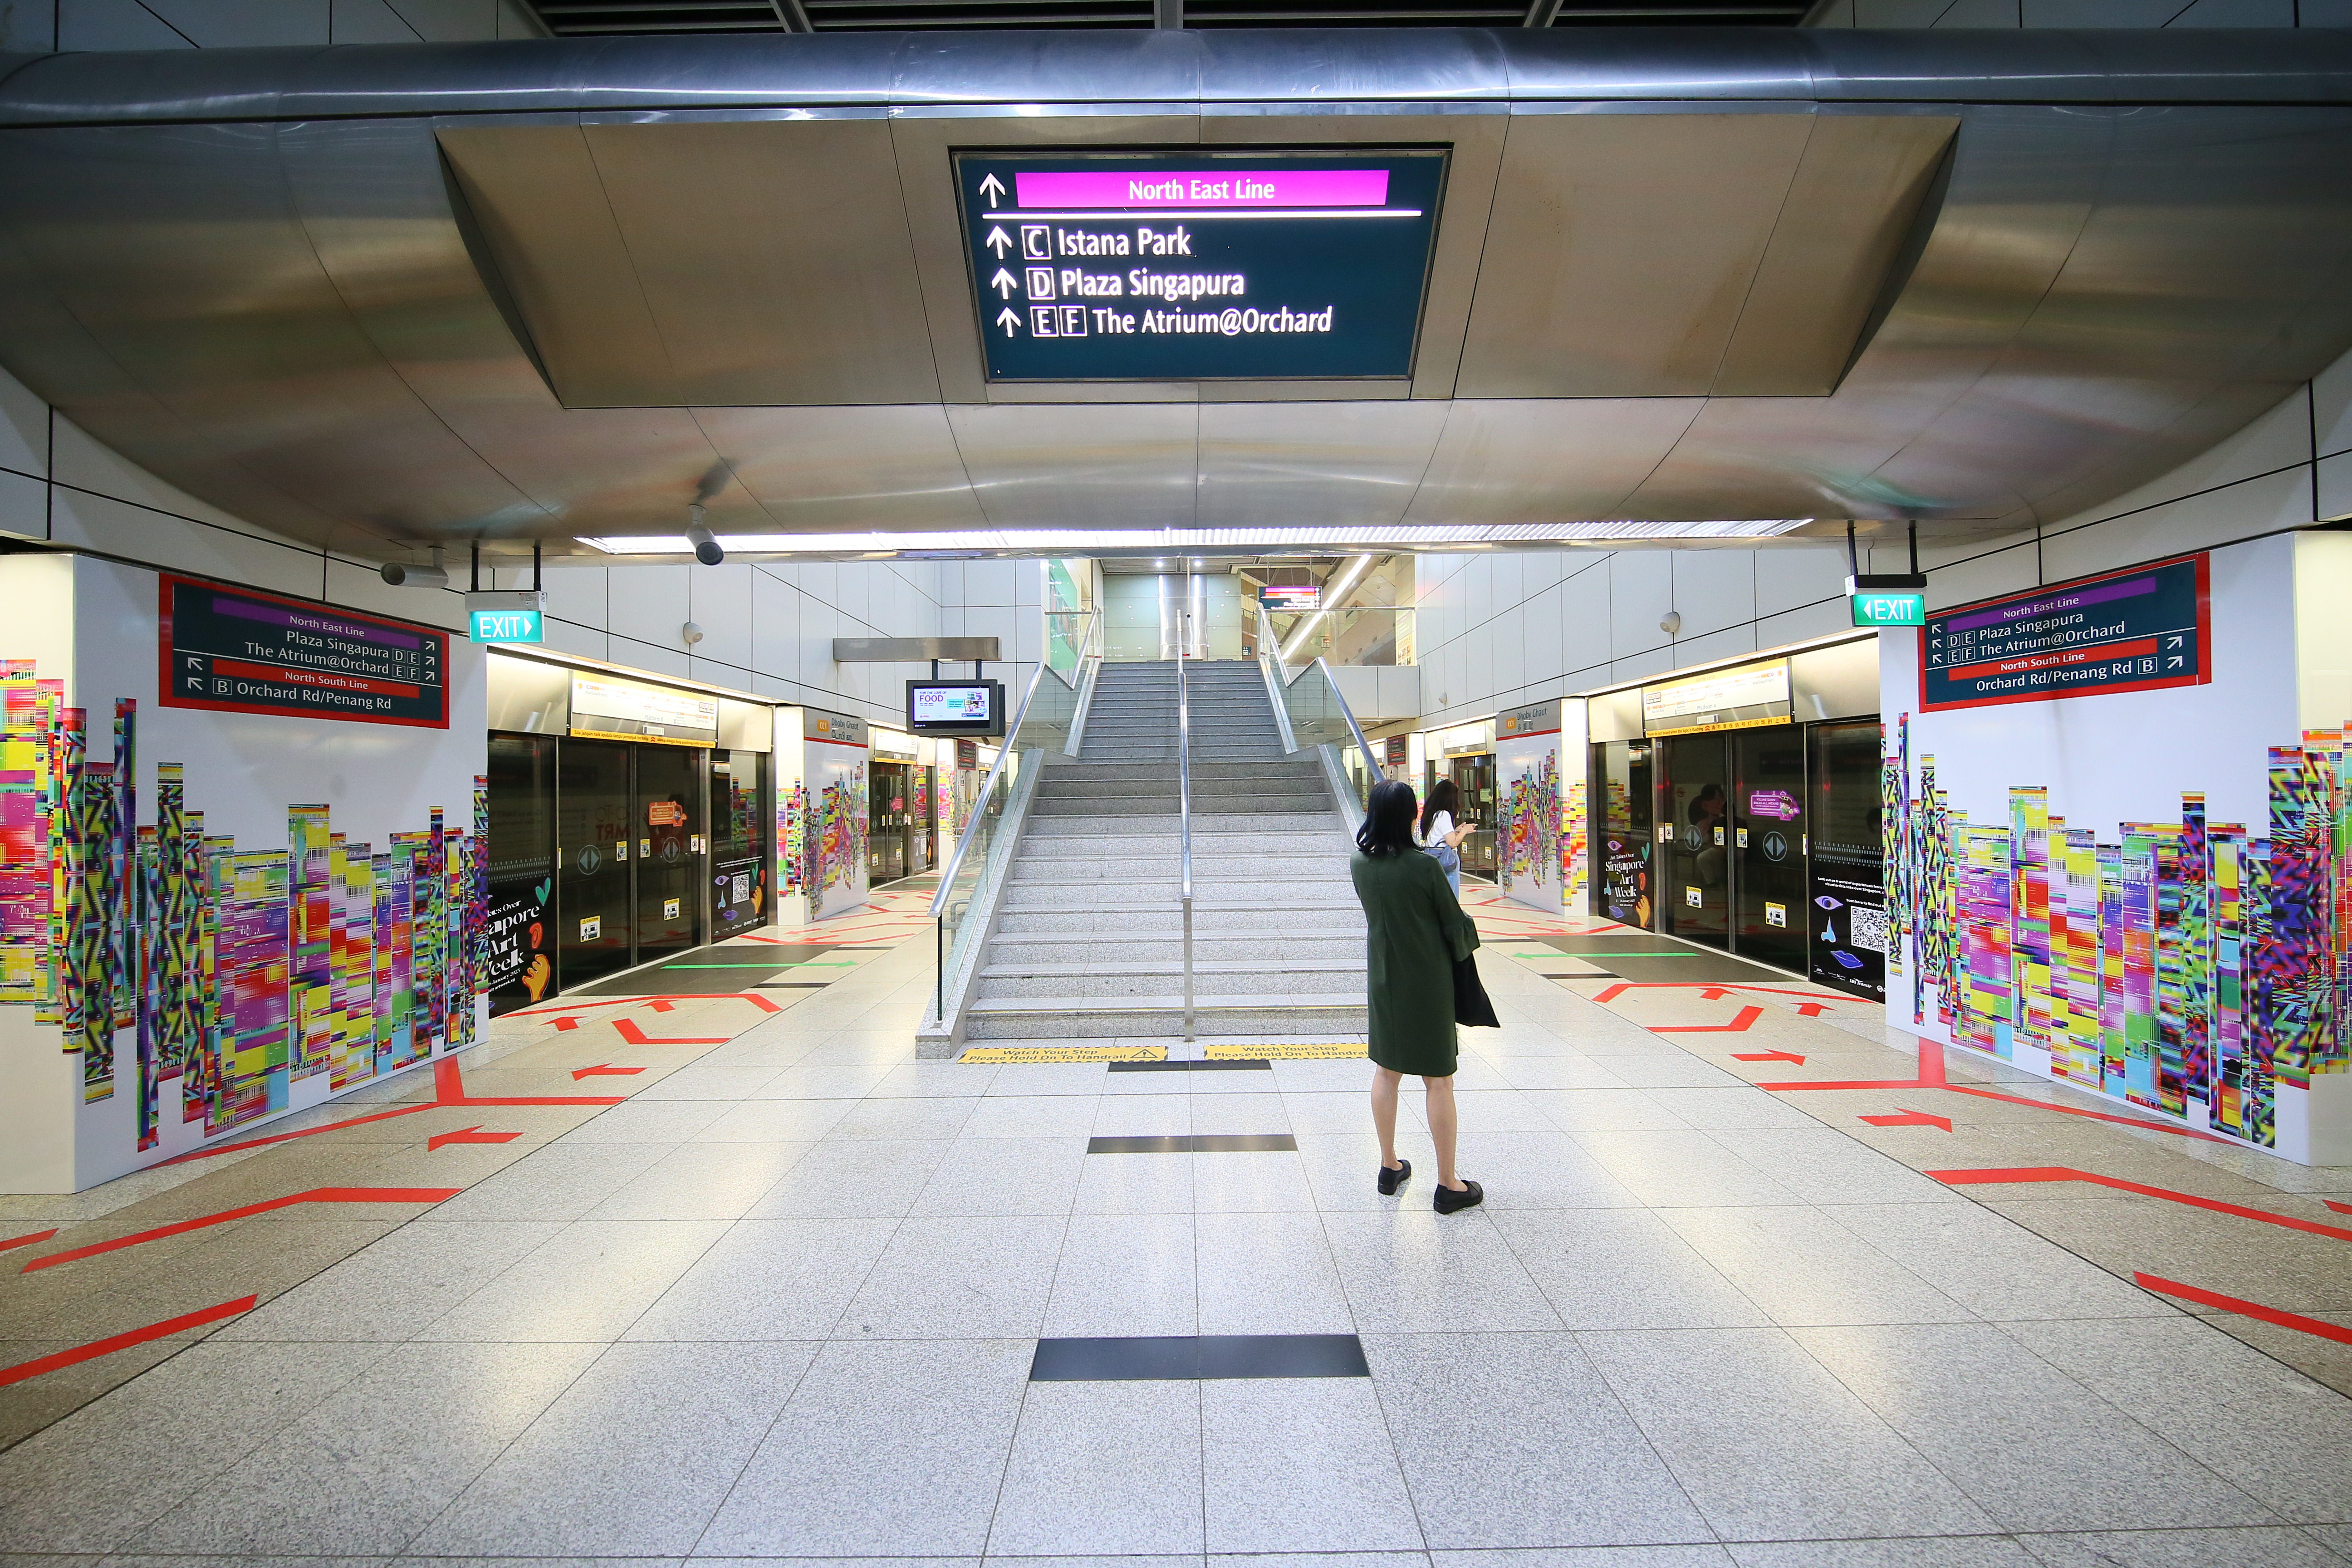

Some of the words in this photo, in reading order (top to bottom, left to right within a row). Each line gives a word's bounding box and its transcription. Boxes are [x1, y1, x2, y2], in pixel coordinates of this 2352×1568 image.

[1130, 179, 1184, 200] North
[1191, 180, 1230, 199] East
[1235, 179, 1274, 199] Line
[1029, 230, 1044, 256] C
[1058, 229, 1129, 255] Istana
[1138, 226, 1191, 255] Park
[1034, 272, 1050, 296] D
[1062, 268, 1122, 295] Plaza
[1129, 268, 1244, 301] Singapura
[1038, 310, 1050, 333] E
[1066, 310, 1078, 333] F
[1093, 308, 1135, 333] The
[1142, 306, 1332, 336] Atrium@Orchard
[1873, 599, 1914, 619] EXIT
[2004, 607, 2030, 618] North
[2034, 602, 2054, 612] East
[2058, 598, 2078, 607] Line
[290, 616, 319, 628] North
[323, 622, 342, 632] East
[346, 627, 364, 637] Line
[480, 616, 520, 637] EXIT
[1950, 636, 1958, 646] D
[1965, 633, 1971, 643] E
[1980, 627, 2010, 640] Plaza
[2016, 614, 2083, 633] Singapura
[287, 631, 322, 647] Plaza
[328, 638, 388, 658] Singapura
[396, 651, 403, 660] D
[411, 653, 416, 663] E
[1980, 644, 2001, 656] The
[2005, 621, 2124, 652] Atrium@Orchard
[245, 642, 273, 657] The
[278, 647, 388, 674] Atrium@Orchard
[2001, 660, 2027, 671] North
[2031, 656, 2059, 666] South
[2063, 653, 2084, 662] Line
[286, 672, 314, 682] North
[318, 676, 346, 686] South
[350, 681, 368, 689] Line
[1977, 675, 2024, 691] Orchard
[2031, 667, 2107, 684] Rd/Penang
[2113, 661, 2131, 675] Rd
[2143, 660, 2153, 672] B
[218, 681, 227, 692] B
[237, 683, 296, 699] Orchard
[304, 690, 372, 709] Rd/Penang
[377, 698, 390, 709] Rd
[831, 718, 845, 729] Dhoby
[847, 720, 859, 730] Ghaut
[1517, 711, 1531, 720] Dhoby
[1533, 708, 1547, 717] Ghaut
[1606, 861, 1644, 874] Singapore
[1620, 874, 1633, 885] Art
[1615, 886, 1637, 897] Week
[503, 900, 521, 911] Over
[488, 906, 540, 936] apore
[488, 932, 518, 958] Art
[1854, 978, 1872, 989] Transit
